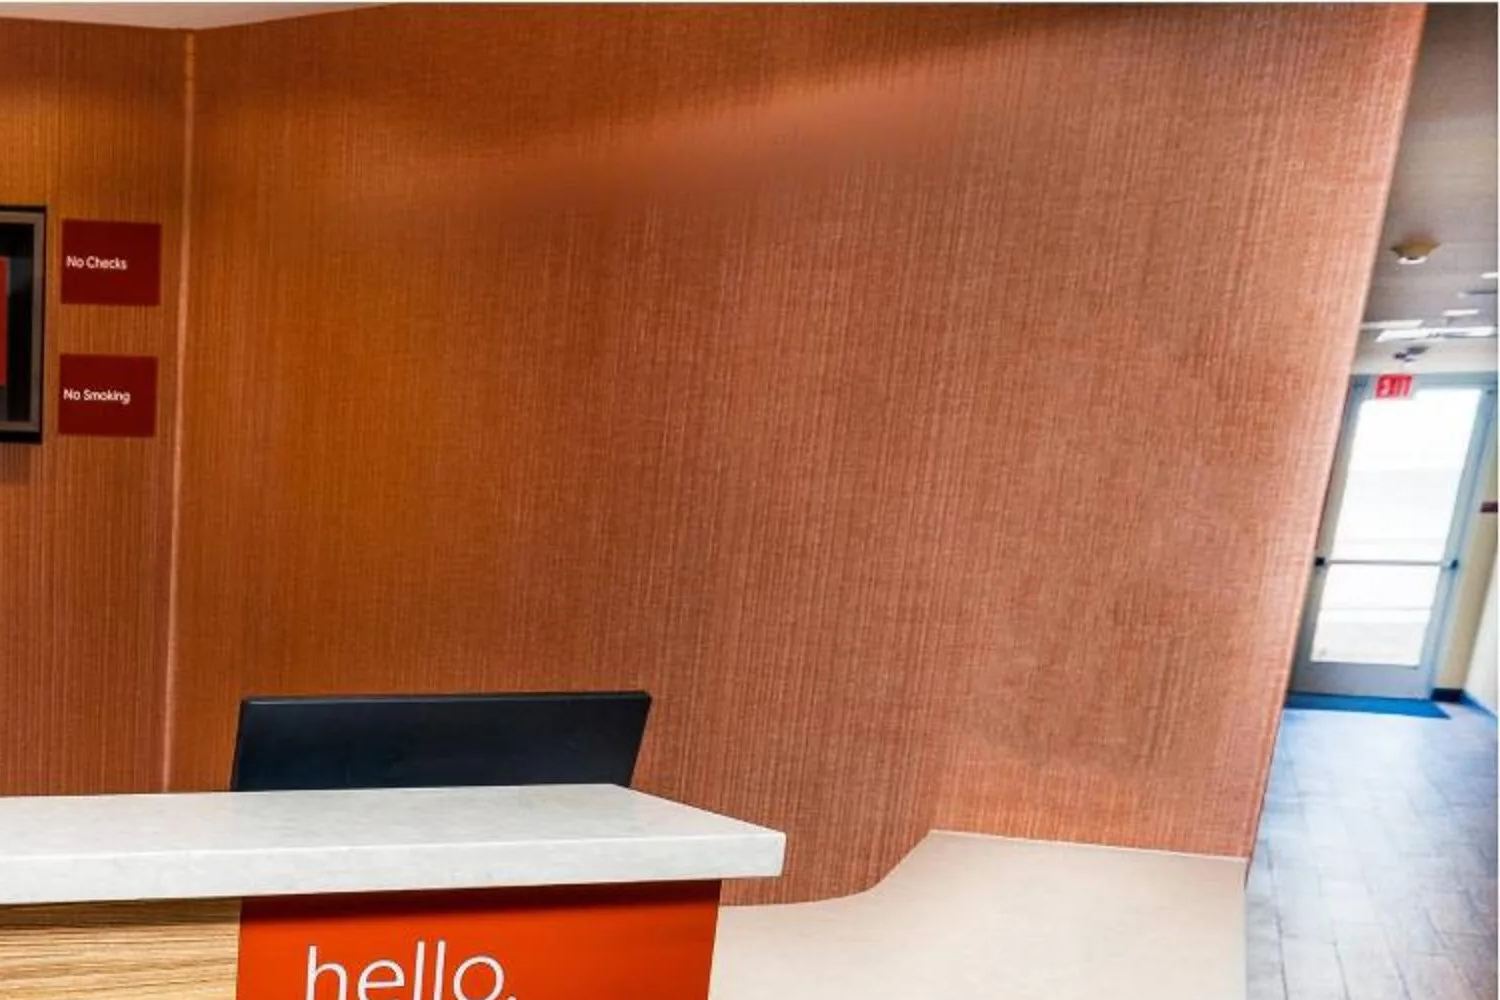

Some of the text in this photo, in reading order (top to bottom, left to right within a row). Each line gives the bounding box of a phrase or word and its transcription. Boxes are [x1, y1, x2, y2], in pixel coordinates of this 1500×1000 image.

[66, 255, 128, 271] No Checks
[63, 388, 130, 405] No Smoking
